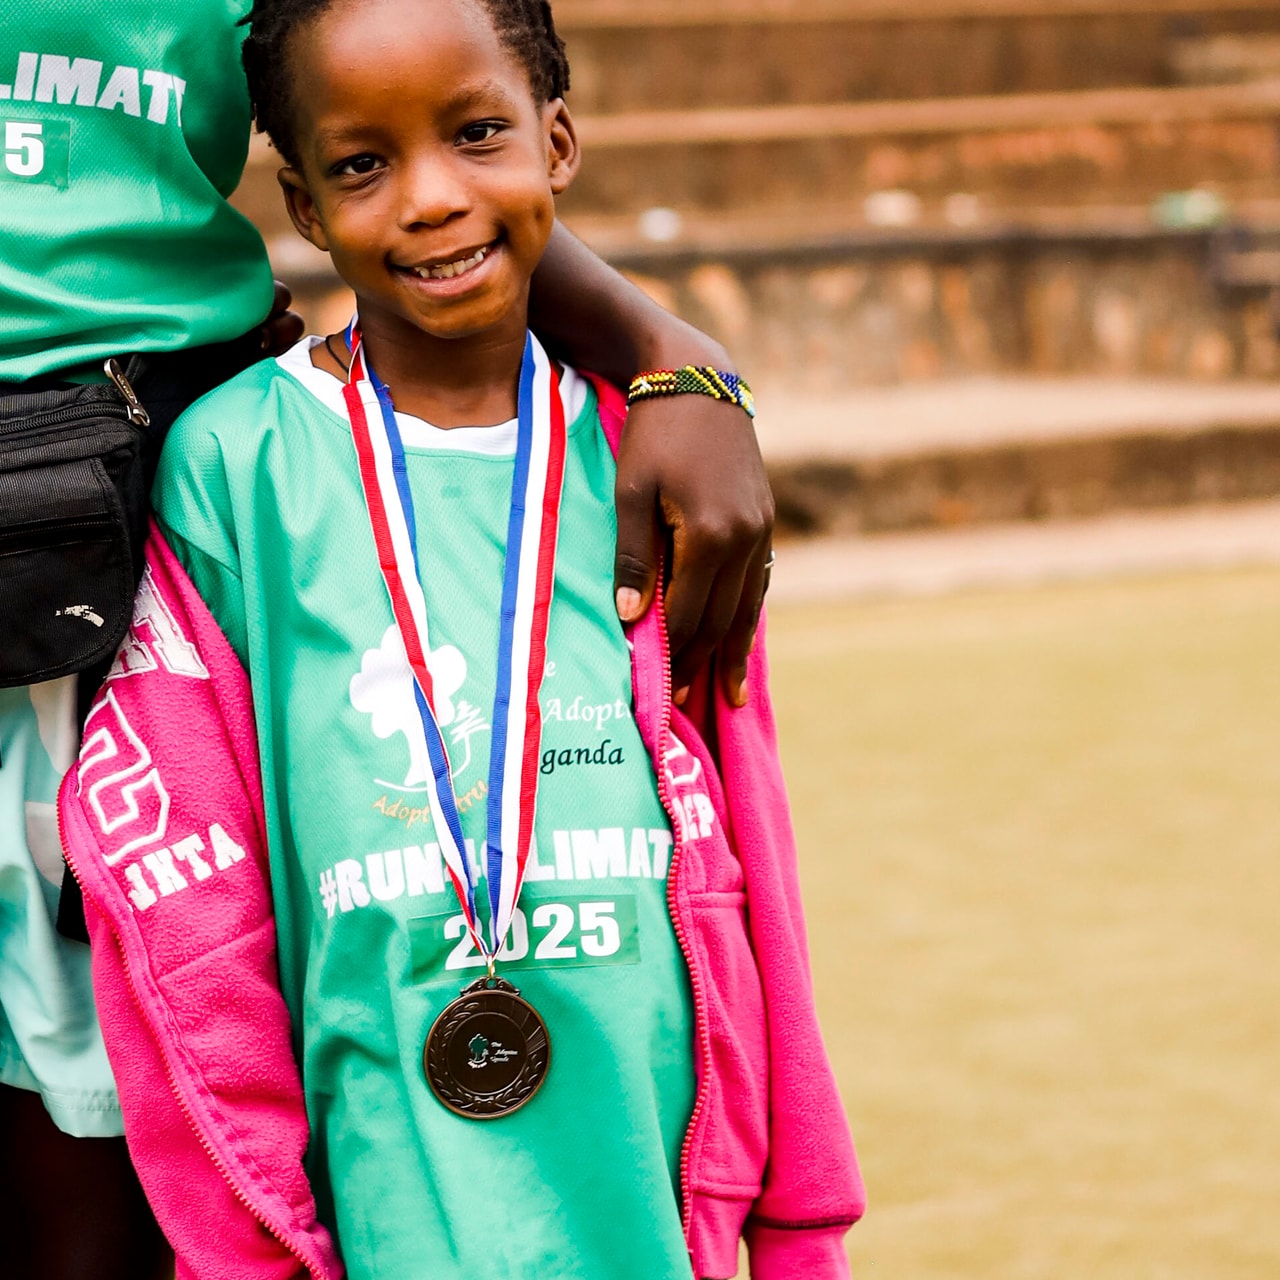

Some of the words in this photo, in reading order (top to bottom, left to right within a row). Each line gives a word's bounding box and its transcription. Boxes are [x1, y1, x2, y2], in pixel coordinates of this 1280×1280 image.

[540, 739, 625, 775] ganda
[372, 794, 430, 830] Adopt
[443, 902, 621, 971] 2025
